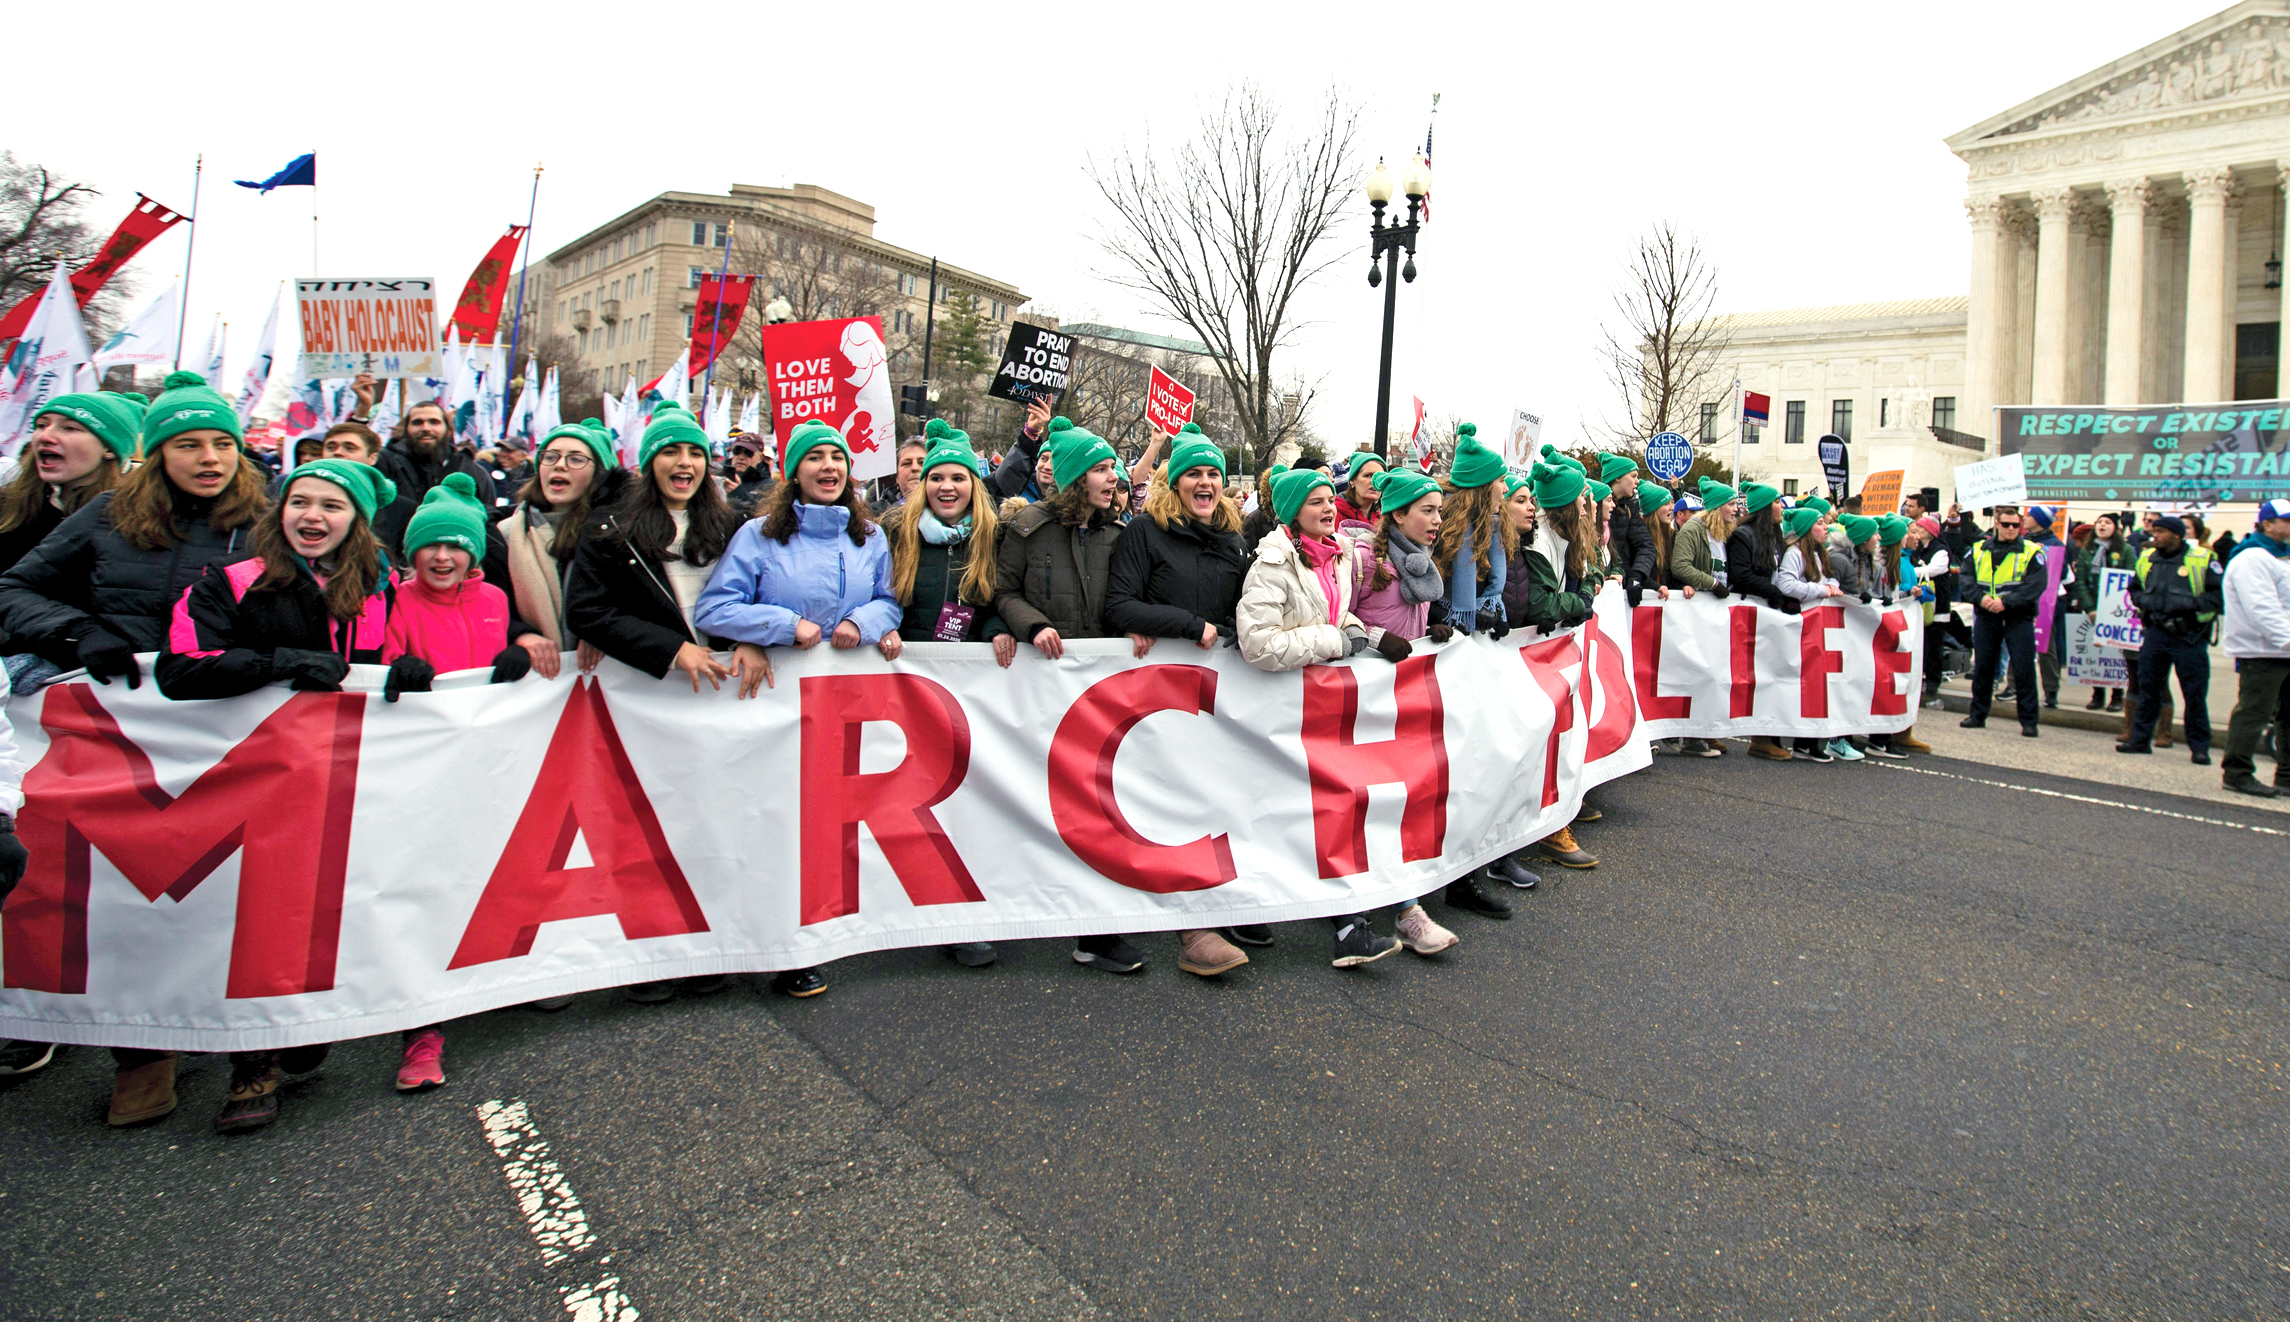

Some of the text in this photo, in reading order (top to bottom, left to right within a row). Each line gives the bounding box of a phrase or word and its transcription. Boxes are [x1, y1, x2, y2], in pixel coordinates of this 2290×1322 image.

[302, 298, 435, 353] BABY HOLOCAUST
[1036, 330, 1071, 354] PRAY
[1024, 346, 1070, 372] TO END
[775, 357, 831, 379] LOVE
[1000, 361, 1068, 390] ABORTION
[777, 377, 834, 399] THEM
[1153, 382, 1180, 411] I VOTE
[781, 396, 836, 419] BOTH
[1520, 411, 1540, 425] CHOOSE
[2020, 413, 2157, 435] RESPECT
[1654, 434, 1683, 446] KEEP
[2153, 437, 2179, 450] OR
[1648, 446, 1690, 460] ABORTION
[1652, 459, 1687, 472] LEGAL
[2023, 454, 2134, 476] EXPECT
[1872, 483, 1901, 492] DEMAND
[2027, 489, 2090, 498] HUMANIZEINTL
[1866, 493, 1898, 502] WITHOUT
[1862, 504, 1892, 512] APOLOGY
[944, 621, 963, 632] TENT
[949, 616, 962, 625] VIP
[2075, 619, 2093, 643] LETH
[2086, 656, 2097, 665] the
[2103, 669, 2130, 680] ACCUS
[2, 653, 1450, 999] MARCH
[1631, 605, 1912, 722] LIFE
